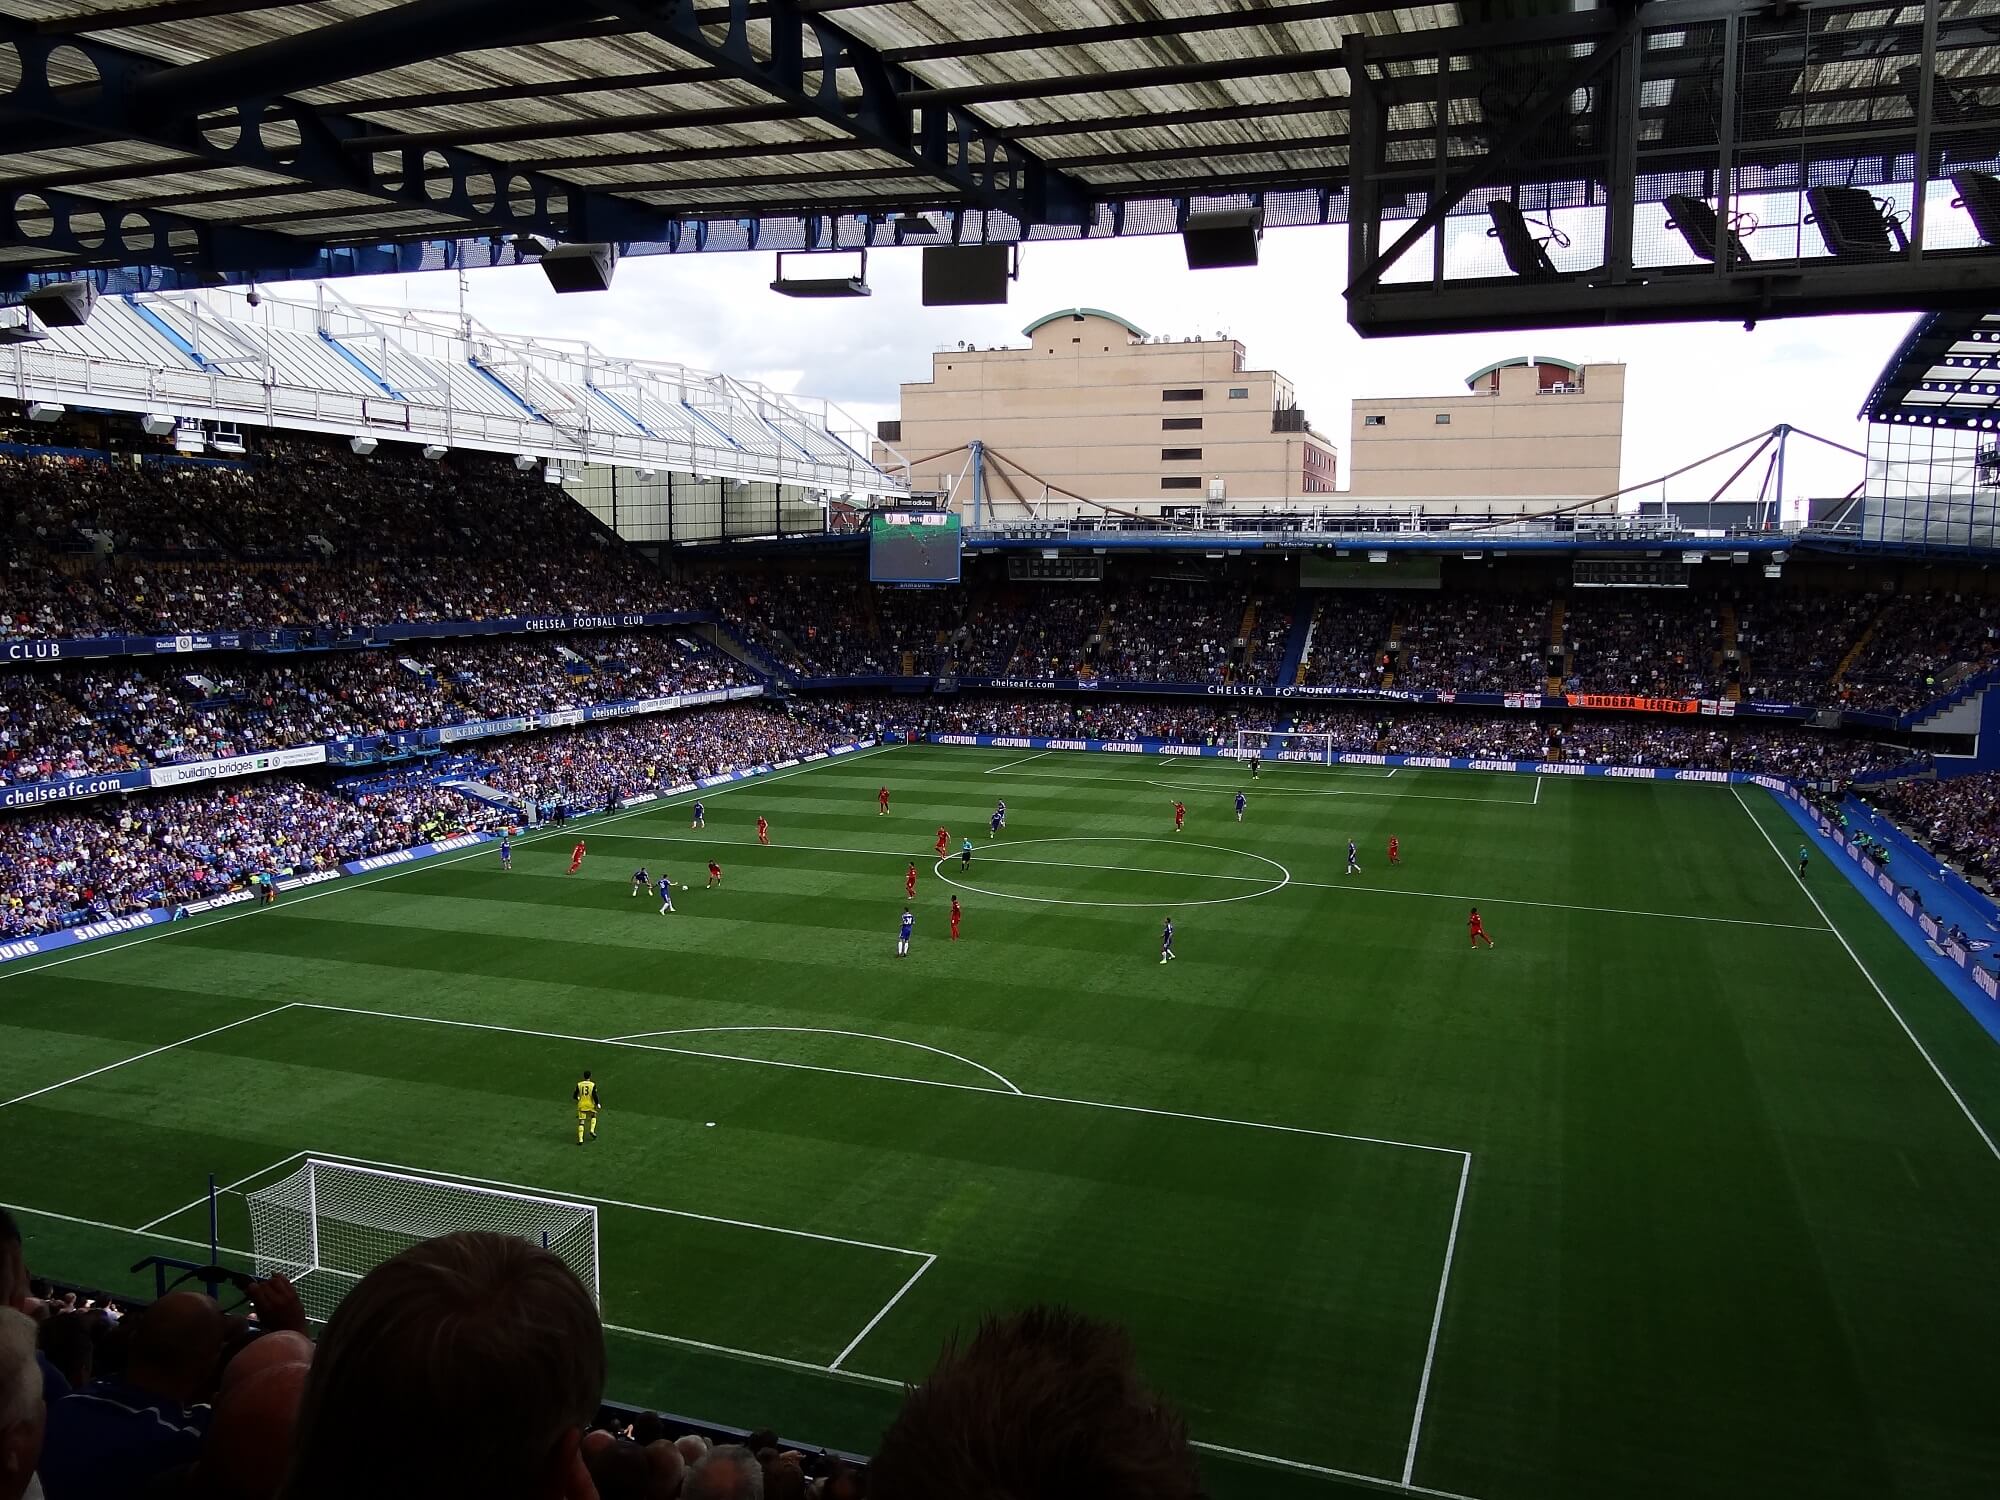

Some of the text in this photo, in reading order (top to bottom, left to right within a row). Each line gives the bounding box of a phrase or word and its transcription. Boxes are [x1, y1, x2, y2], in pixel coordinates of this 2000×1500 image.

[525, 615, 644, 630] CHELSEA FOOTBALL CLUB
[9, 643, 60, 659] CLUB
[991, 679, 1055, 689] chelseafc.com
[1207, 685, 1263, 696] CHELSEA
[1379, 690, 1409, 699] KING
[1588, 696, 1635, 708] DROGBA
[1643, 699, 1688, 712] LEGEND
[592, 703, 639, 719] chelseafc.com
[456, 722, 512, 737] KERRY BLUES
[944, 735, 977, 745] GAZPROM
[996, 738, 1031, 748] GAZPROM
[1051, 740, 1086, 750] GAZPROM
[1107, 743, 1143, 753] GAZPROM
[1164, 745, 1200, 756] GAZPROM
[1345, 754, 1385, 765] GAZPROM
[1409, 756, 1450, 768] GAZPROM
[178, 761, 253, 780] building bridges
[1475, 760, 1516, 772] GAZPROM
[1541, 764, 1584, 775] GAZPROM
[1611, 767, 1655, 778] GAZPROM
[1682, 770, 1727, 782] GAZPROM
[6, 779, 121, 805] chelseafc.com
[432, 834, 481, 853] SAMSUNG
[360, 850, 414, 871] SAMSUNG
[301, 869, 341, 885] adidas
[210, 889, 255, 907] adidas
[73, 913, 154, 941] SAMSUNG
[581, 1086, 590, 1096] 13
